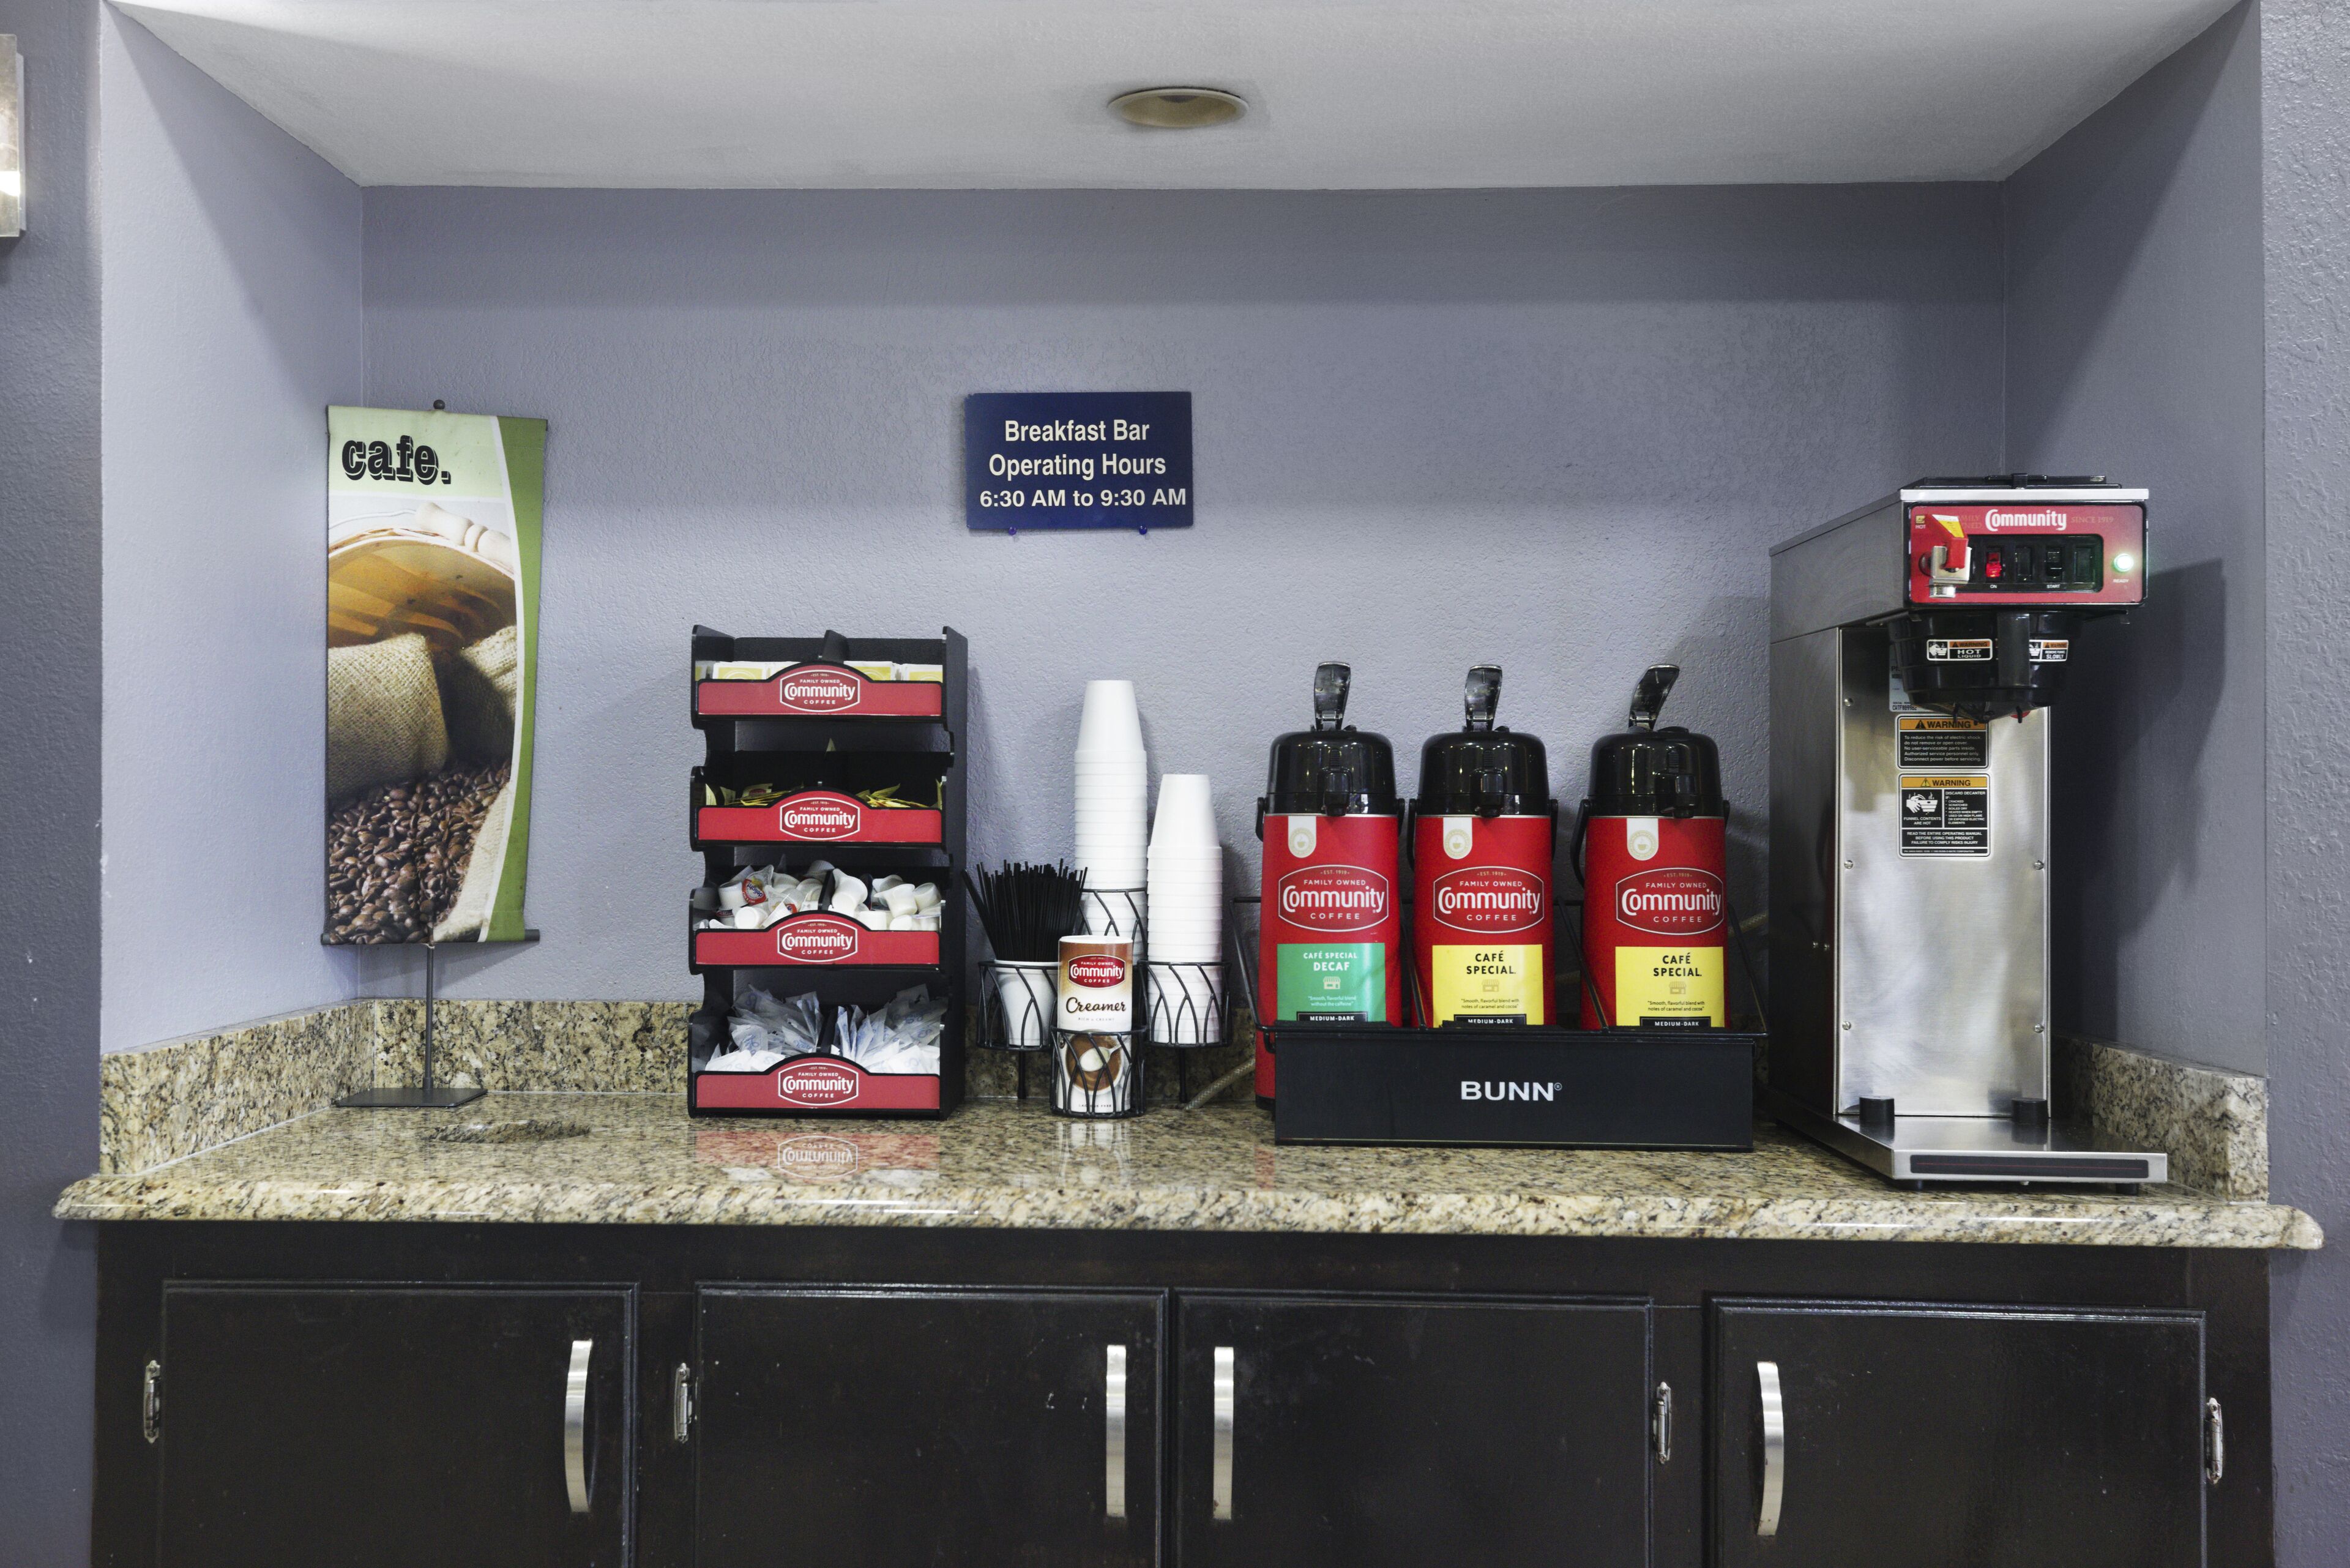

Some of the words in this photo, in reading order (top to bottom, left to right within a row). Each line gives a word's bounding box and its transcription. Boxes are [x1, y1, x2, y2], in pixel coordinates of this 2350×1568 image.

[1005, 420, 1106, 441] Breakfast
[1113, 419, 1149, 441] Bar
[341, 435, 451, 485] cafe.
[989, 454, 1094, 481] Operating
[1102, 453, 1166, 474] Hours
[980, 490, 1024, 507] 6:30
[1032, 490, 1065, 506] AM
[1073, 490, 1094, 506] to
[1101, 489, 1145, 506] 9:30
[1152, 488, 1186, 505] AM
[1985, 509, 2067, 531] Community
[785, 683, 856, 700] Community
[785, 810, 856, 828] Community
[1283, 886, 1384, 913] Community
[1438, 887, 1540, 914] Community
[1622, 889, 1721, 916] Community
[782, 933, 853, 950] Community
[1475, 950, 1504, 961] CAFÉ
[1663, 952, 1690, 964] CAFÉ
[1070, 964, 1124, 979] Community
[1313, 962, 1349, 971] DECAF
[1066, 997, 1126, 1014] Creamer
[783, 1076, 854, 1094] Community
